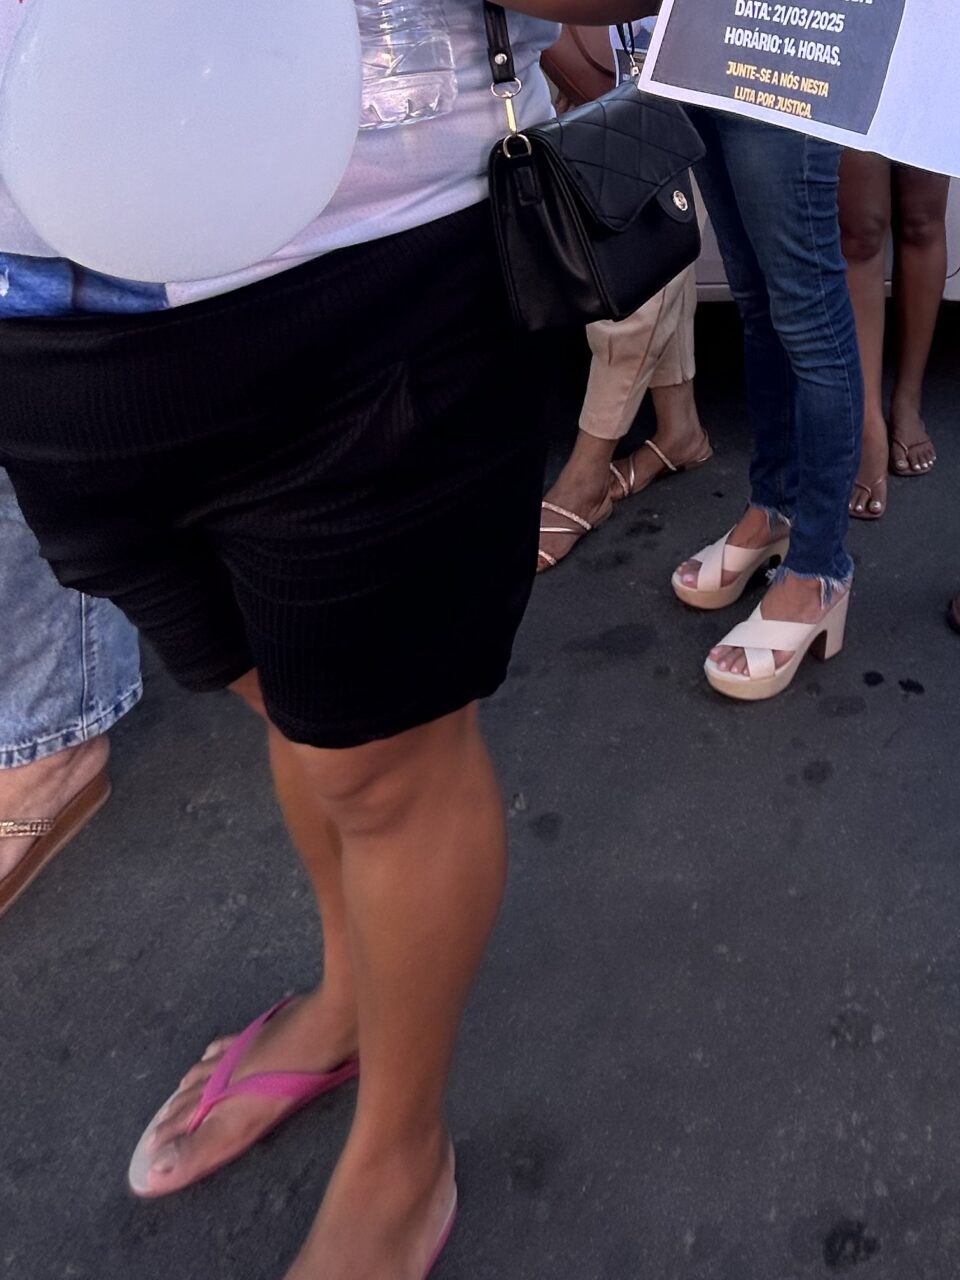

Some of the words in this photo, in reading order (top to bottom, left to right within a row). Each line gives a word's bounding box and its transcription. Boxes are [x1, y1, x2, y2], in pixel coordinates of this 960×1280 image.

[772, 4, 845, 33] 21/03/2025
[724, 26, 782, 54] HORÁRIO:
[783, 37, 796, 57] 14
[798, 39, 841, 67] HORAS.
[726, 61, 772, 84] JUNTE-SE
[771, 70, 779, 86] A
[780, 71, 800, 90] NÓS
[800, 77, 829, 98] NESTA
[734, 85, 756, 103] LUTA
[756, 90, 776, 109] POR
